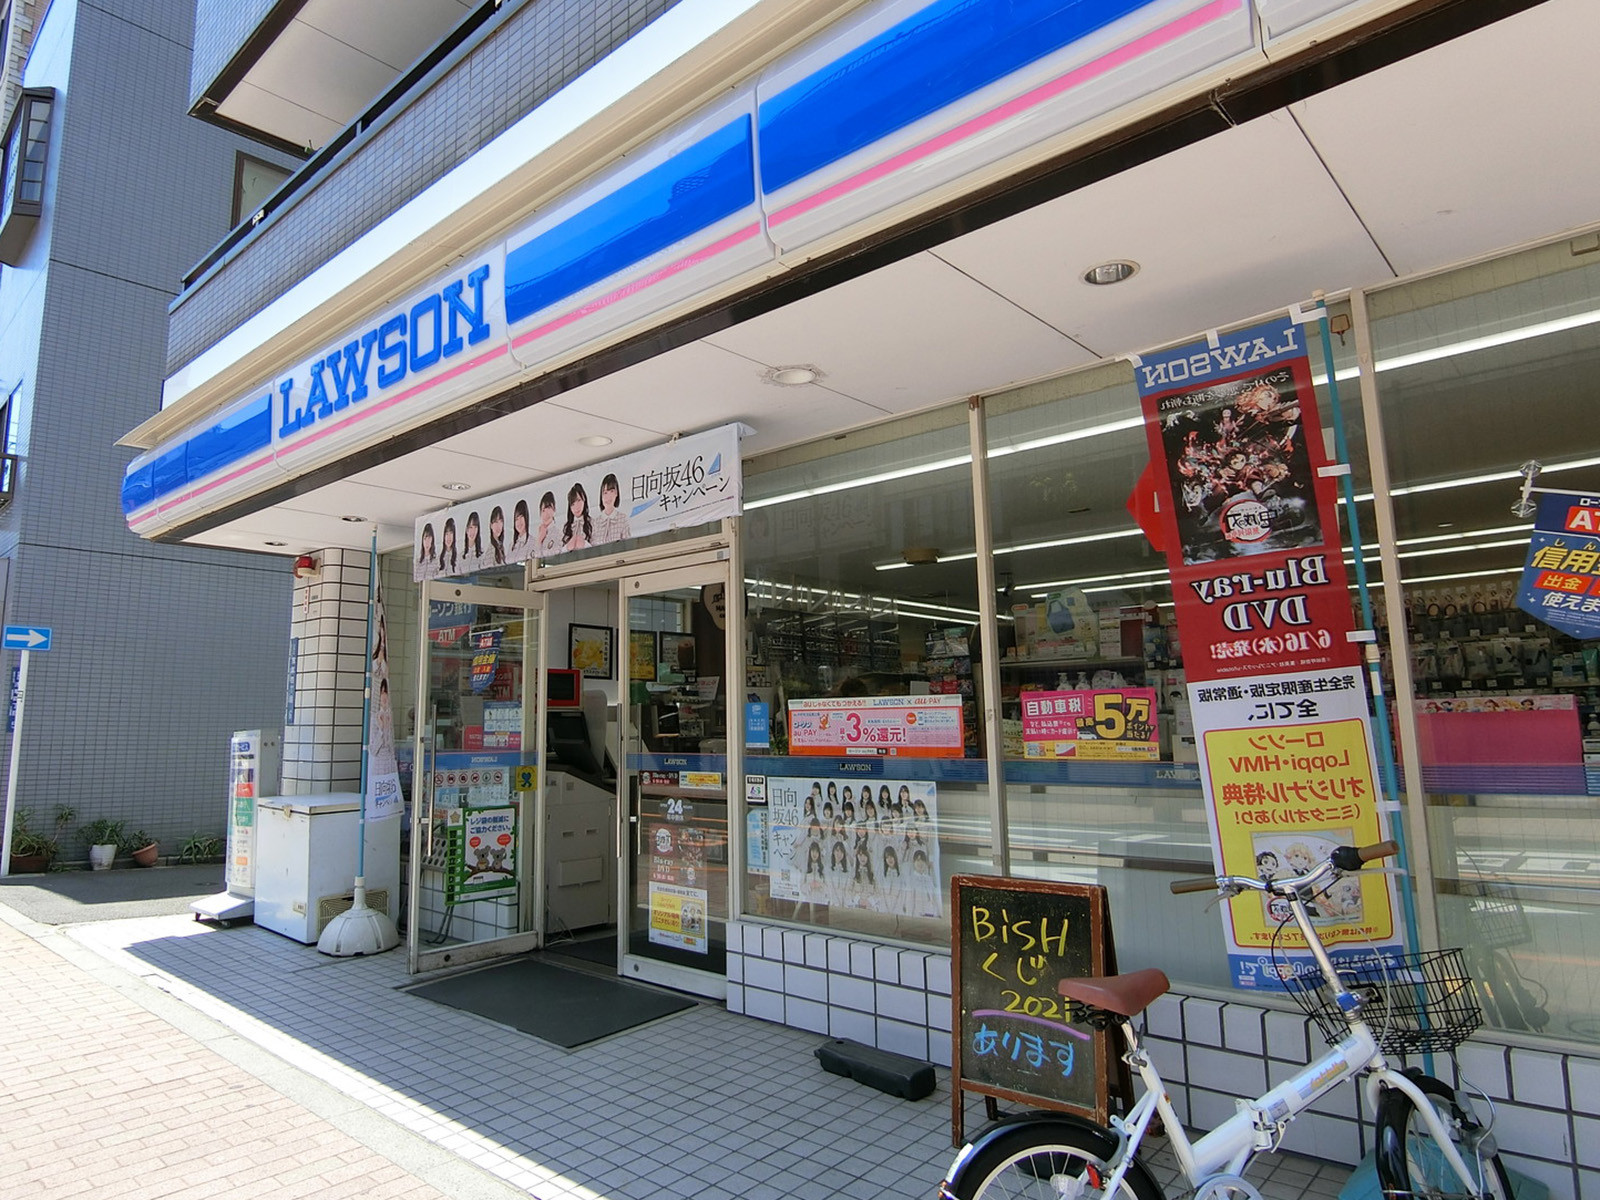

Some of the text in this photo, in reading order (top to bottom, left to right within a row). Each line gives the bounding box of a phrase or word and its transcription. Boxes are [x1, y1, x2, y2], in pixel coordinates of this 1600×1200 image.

[279, 263, 491, 440] LAWSON
[631, 455, 705, 502] 日向坂46
[659, 475, 731, 512] キャンペーン
[1530, 546, 1600, 576] 信用
[1542, 574, 1582, 591] 出金
[438, 628, 456, 643] ATM
[873, 698, 905, 707] LAWSON
[928, 697, 942, 705] PAY
[1027, 697, 1082, 716] 自動車税
[804, 729, 818, 737] PAY
[839, 763, 873, 772] LAWSON
[667, 797, 684, 815] 24
[772, 787, 798, 808] 日向
[772, 807, 800, 827] 坂46
[773, 830, 799, 848] キャン
[773, 848, 798, 861] ペーン
[972, 905, 1069, 957] BiSH
[981, 952, 1047, 986] くじ
[1001, 989, 1071, 1023] 2021
[972, 1022, 1075, 1077] あります
